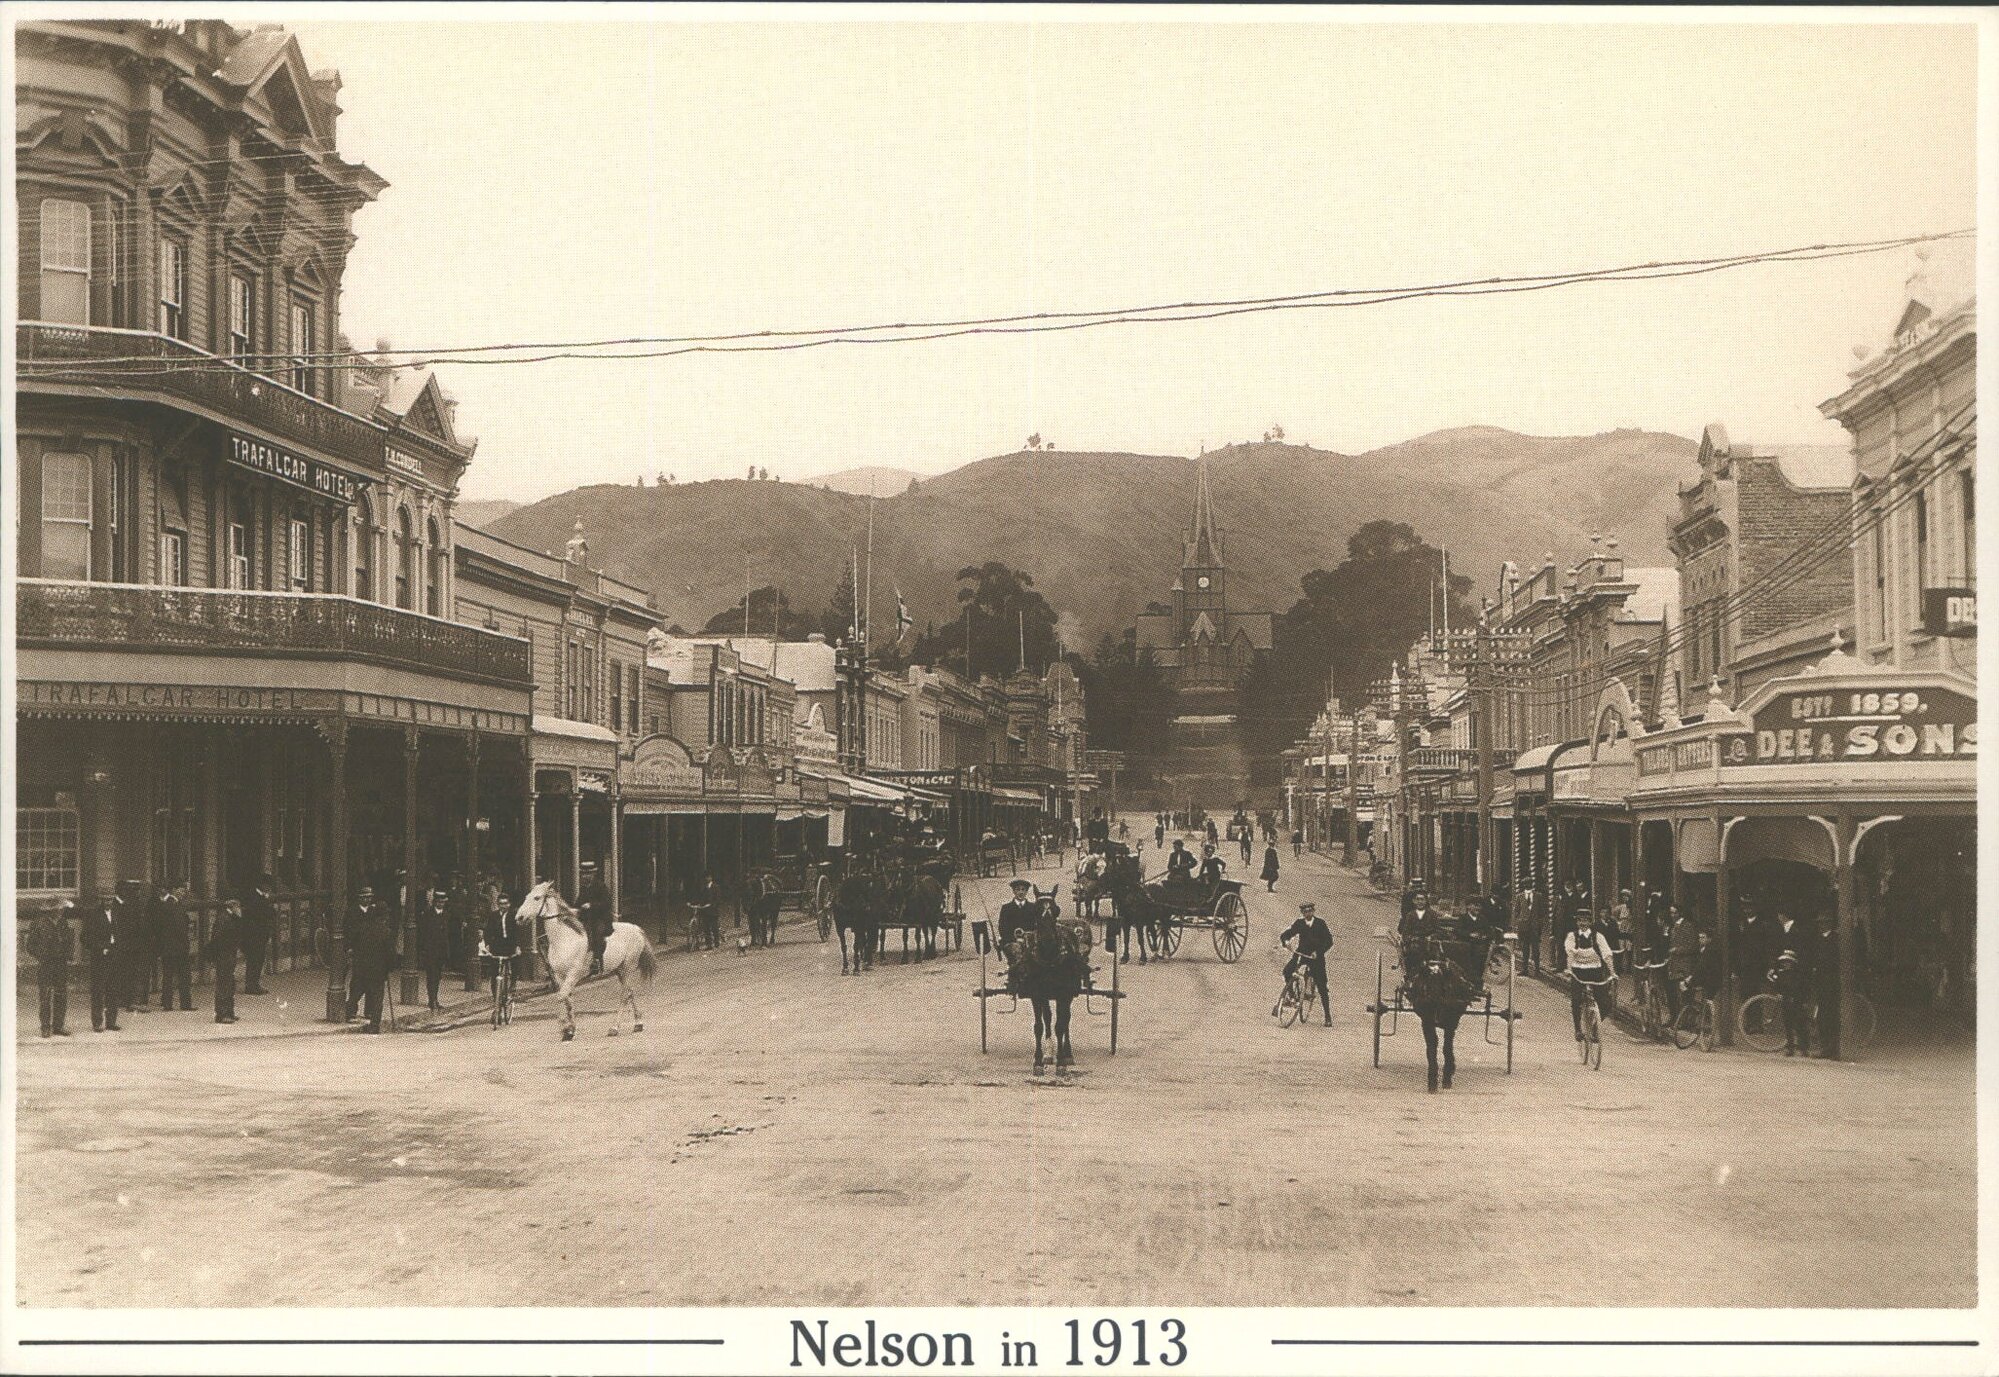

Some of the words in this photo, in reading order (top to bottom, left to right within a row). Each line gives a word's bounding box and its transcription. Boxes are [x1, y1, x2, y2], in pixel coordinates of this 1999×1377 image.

[232, 437, 307, 482] TRAFALGAR
[315, 467, 354, 499] HOTEL
[31, 683, 193, 706] TRAFALGAR
[217, 688, 303, 709] HOTEL
[1756, 727, 1814, 759] DEE
[1820, 733, 1835, 757] &
